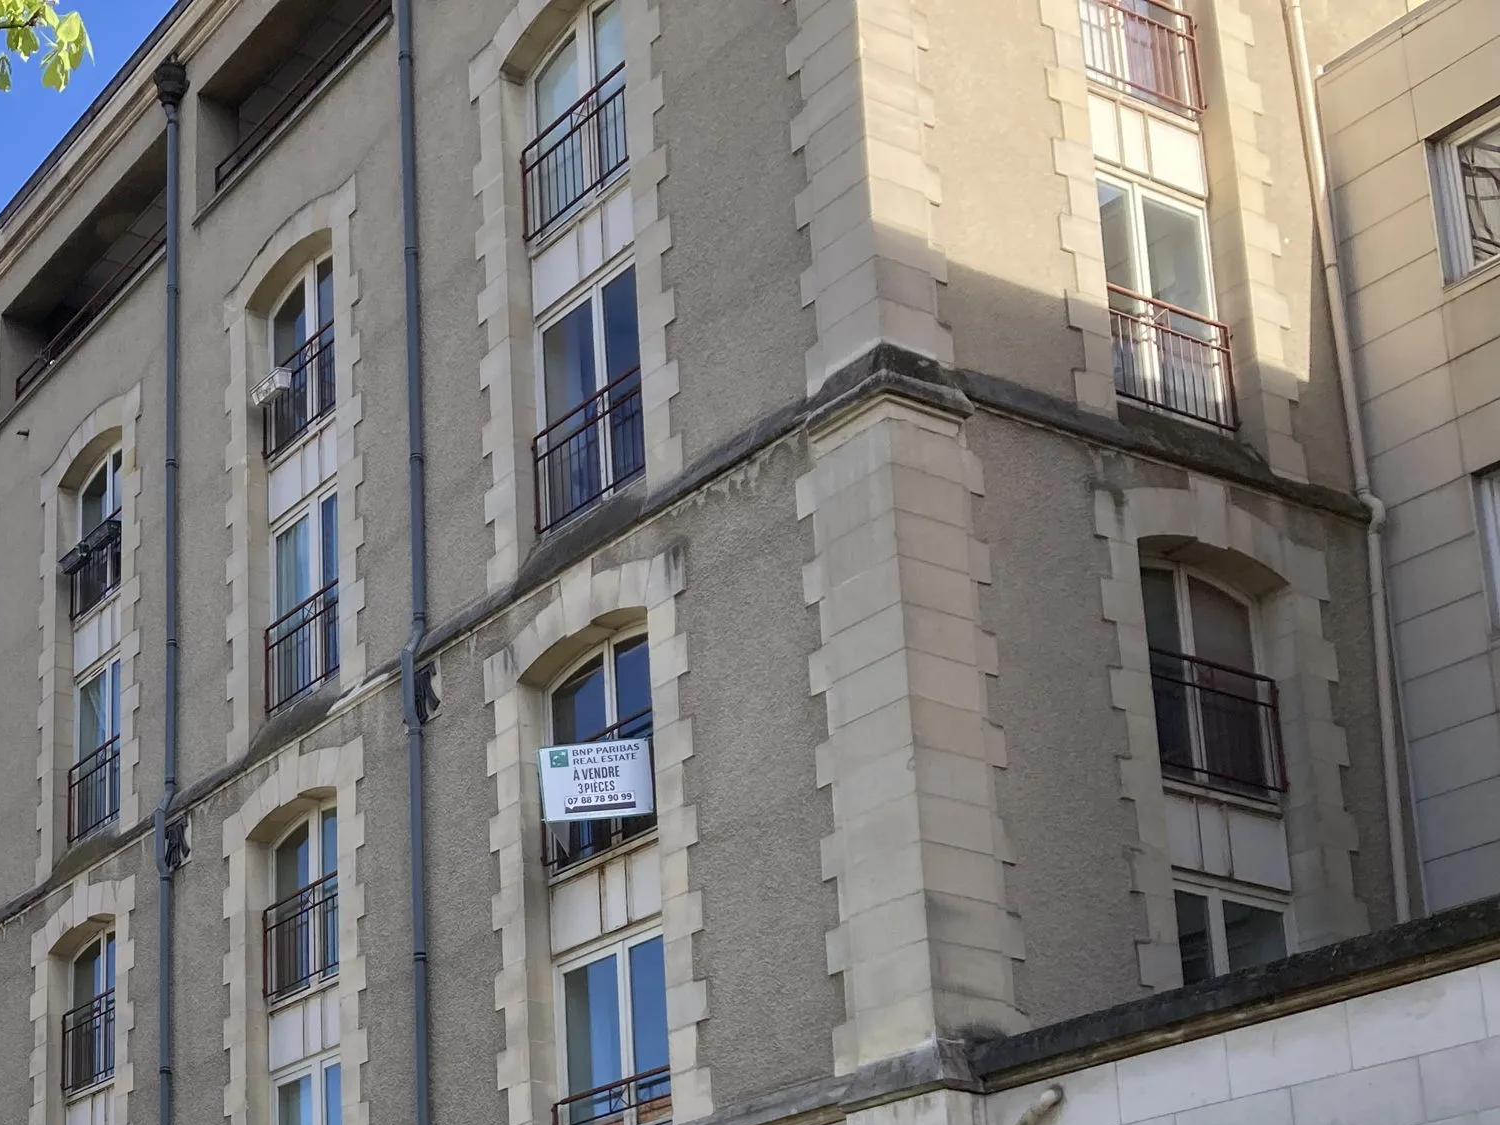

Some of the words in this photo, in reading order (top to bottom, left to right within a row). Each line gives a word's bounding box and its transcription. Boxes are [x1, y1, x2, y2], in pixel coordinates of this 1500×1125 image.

[572, 748, 593, 757] BNP
[596, 743, 640, 755] PARIBAS
[573, 756, 600, 765] REAL
[601, 752, 637, 763] ESTATE
[573, 766, 581, 781] À
[582, 765, 620, 780] VENDRE
[577, 783, 583, 794] 3
[567, 797, 578, 805] 07
[581, 795, 592, 804] 88
[595, 794, 606, 803] 78
[607, 793, 619, 802] 90
